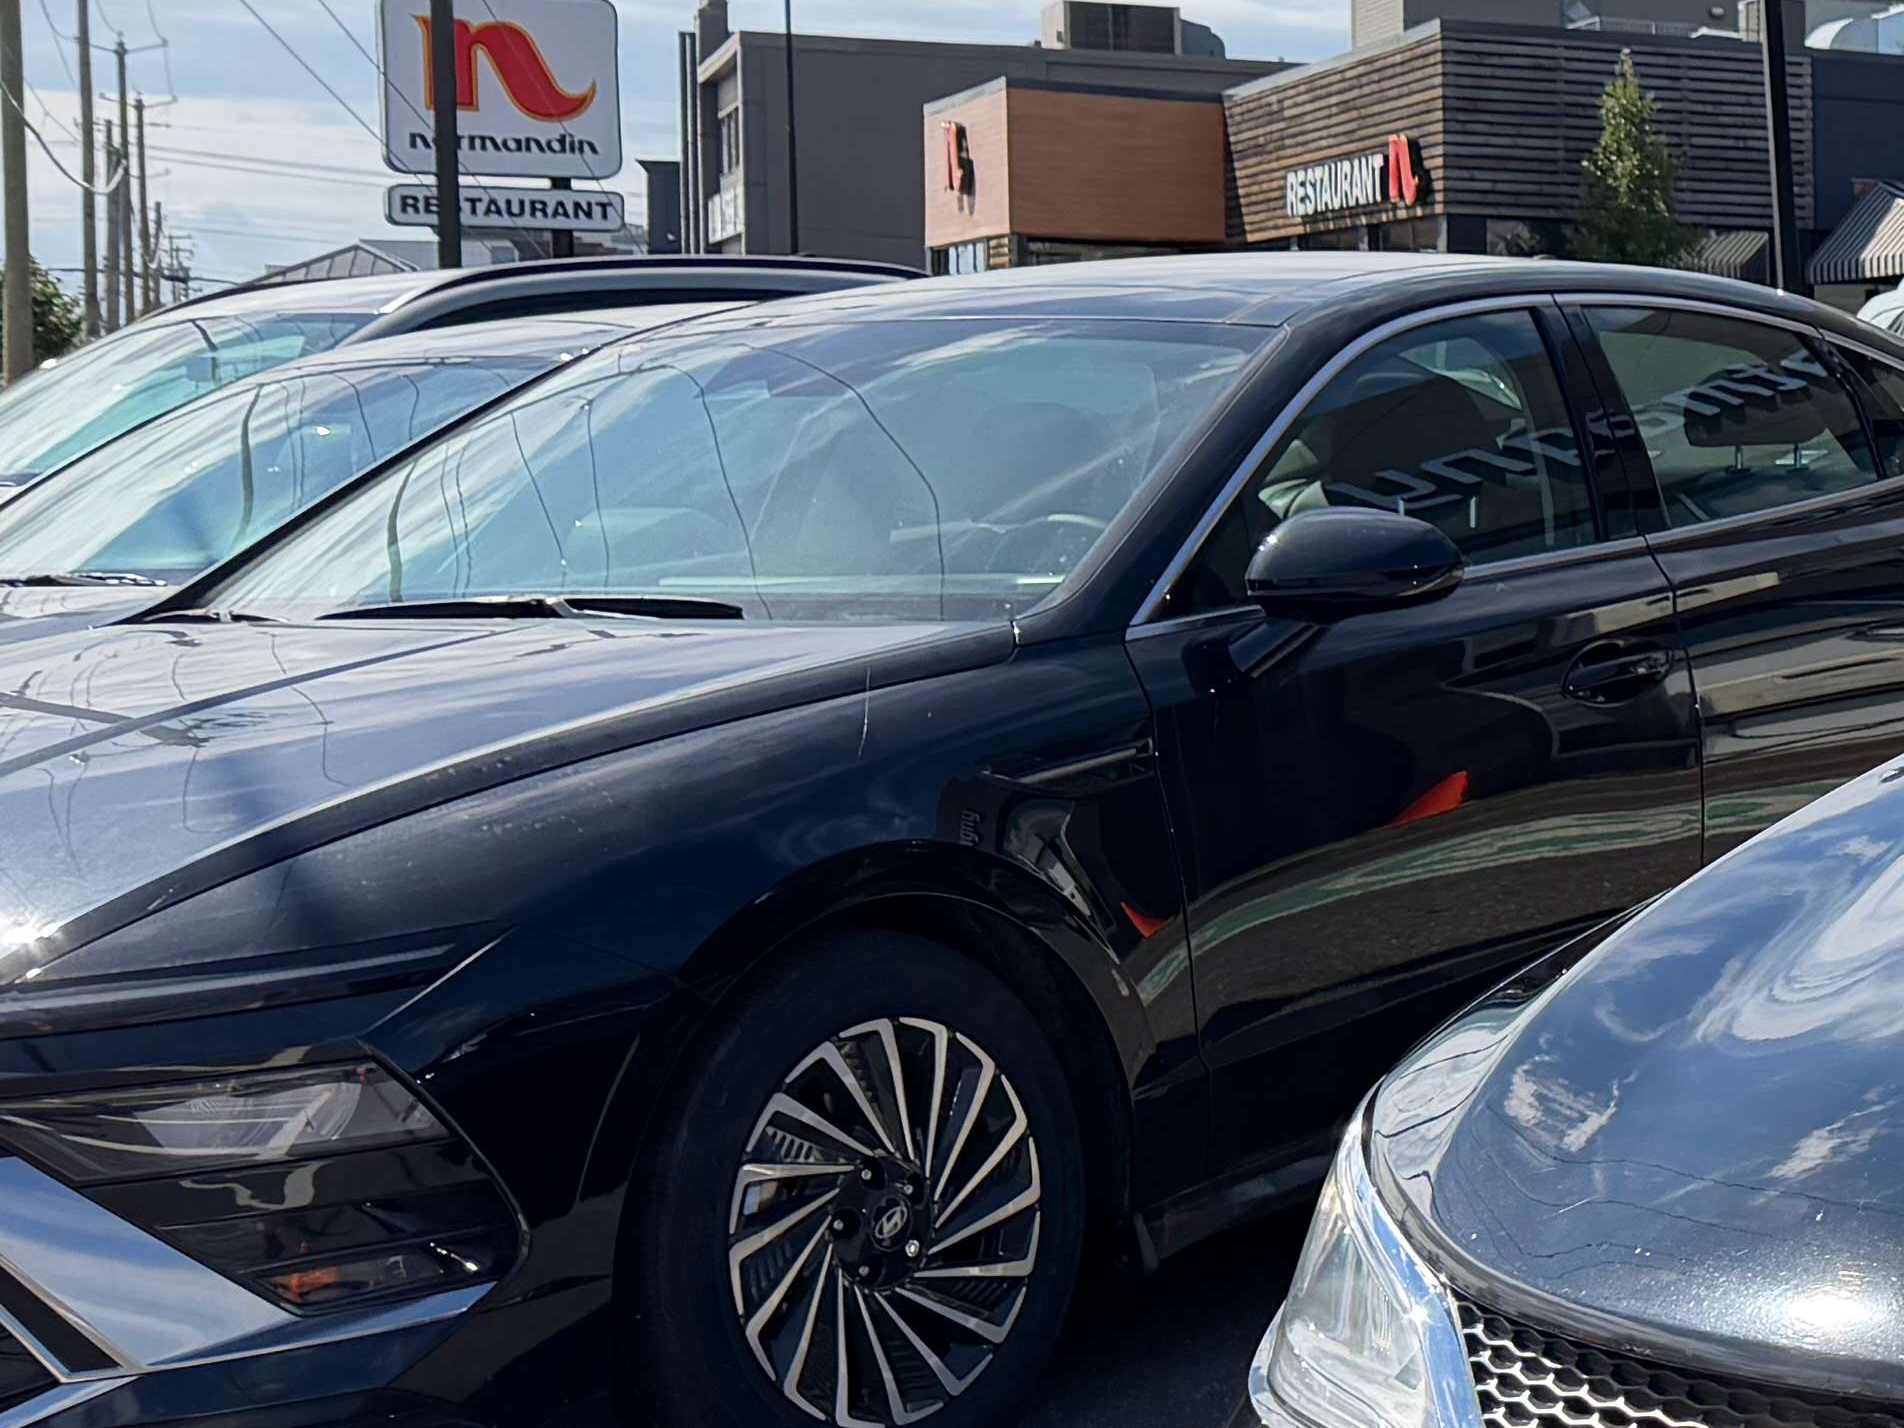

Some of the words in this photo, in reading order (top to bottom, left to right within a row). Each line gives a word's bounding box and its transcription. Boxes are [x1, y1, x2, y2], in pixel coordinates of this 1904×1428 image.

[408, 131, 600, 156] nrmandin
[1286, 153, 1384, 218] RESTAURANT
[399, 193, 614, 222] RETAURANT
